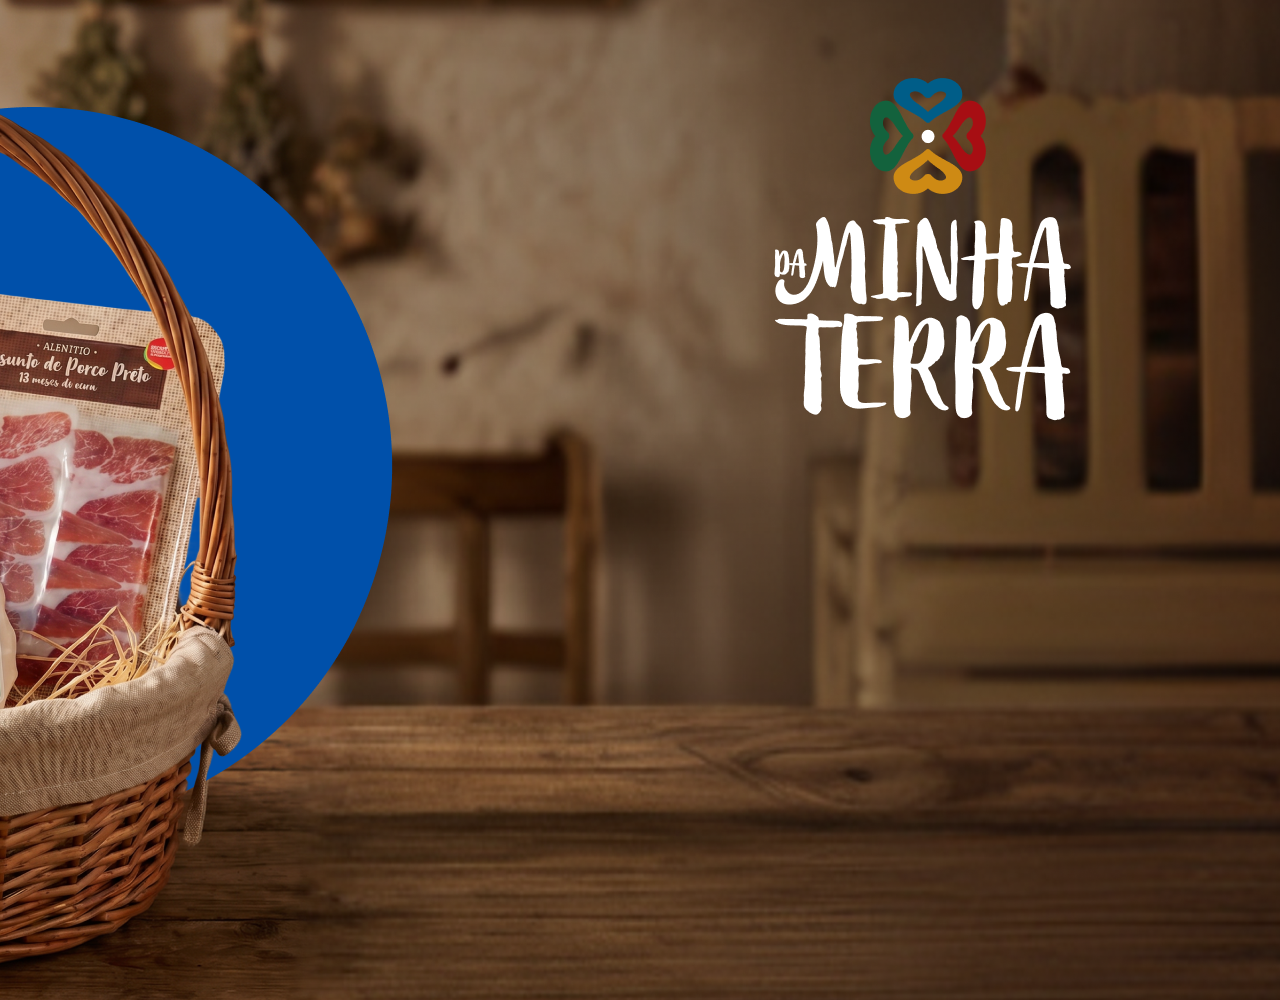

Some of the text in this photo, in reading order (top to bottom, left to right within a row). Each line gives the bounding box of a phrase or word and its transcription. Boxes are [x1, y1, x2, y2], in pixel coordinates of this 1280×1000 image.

[43, 355, 62, 372] de
[65, 356, 109, 377] Porco
[18, 371, 30, 383] 13
[31, 376, 60, 388] meses
